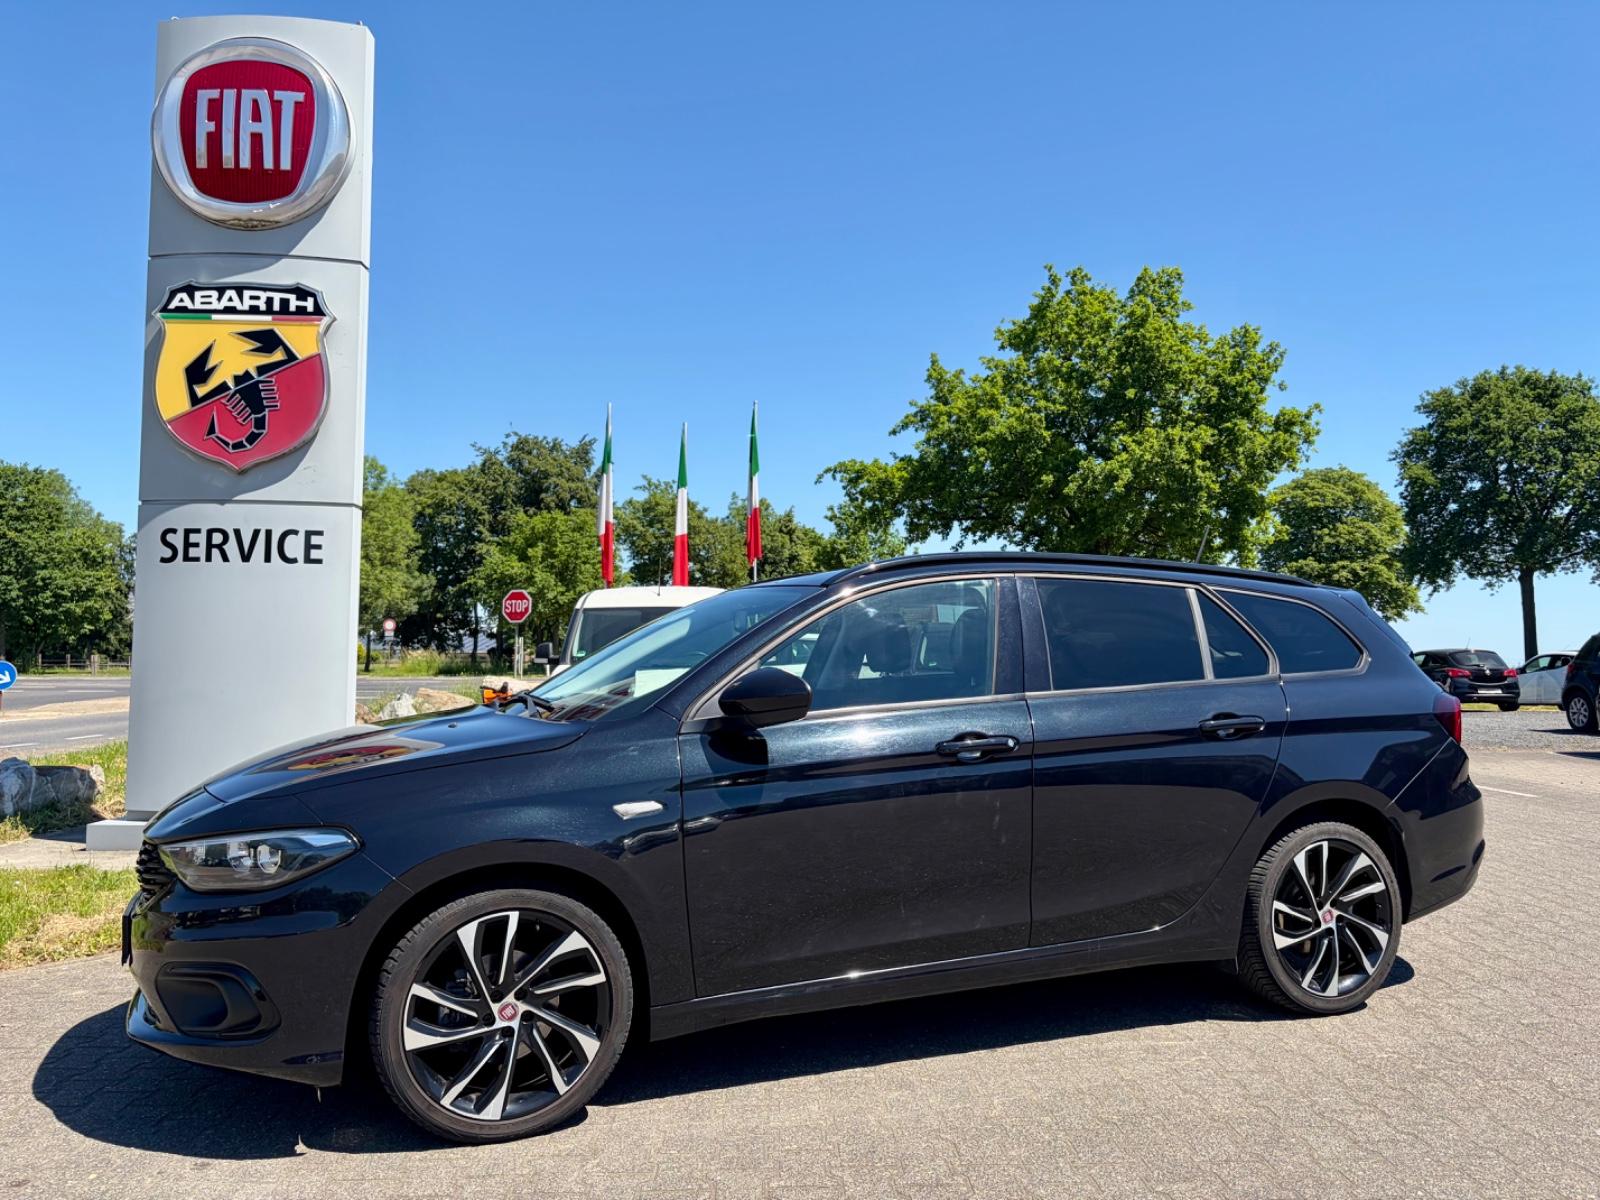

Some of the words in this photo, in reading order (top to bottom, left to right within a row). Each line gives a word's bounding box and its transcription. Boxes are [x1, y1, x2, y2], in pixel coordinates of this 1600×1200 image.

[195, 88, 306, 171] FIAT
[167, 289, 314, 313] ABARTH
[159, 527, 325, 565] SERVICE
[505, 599, 529, 613] STOP
